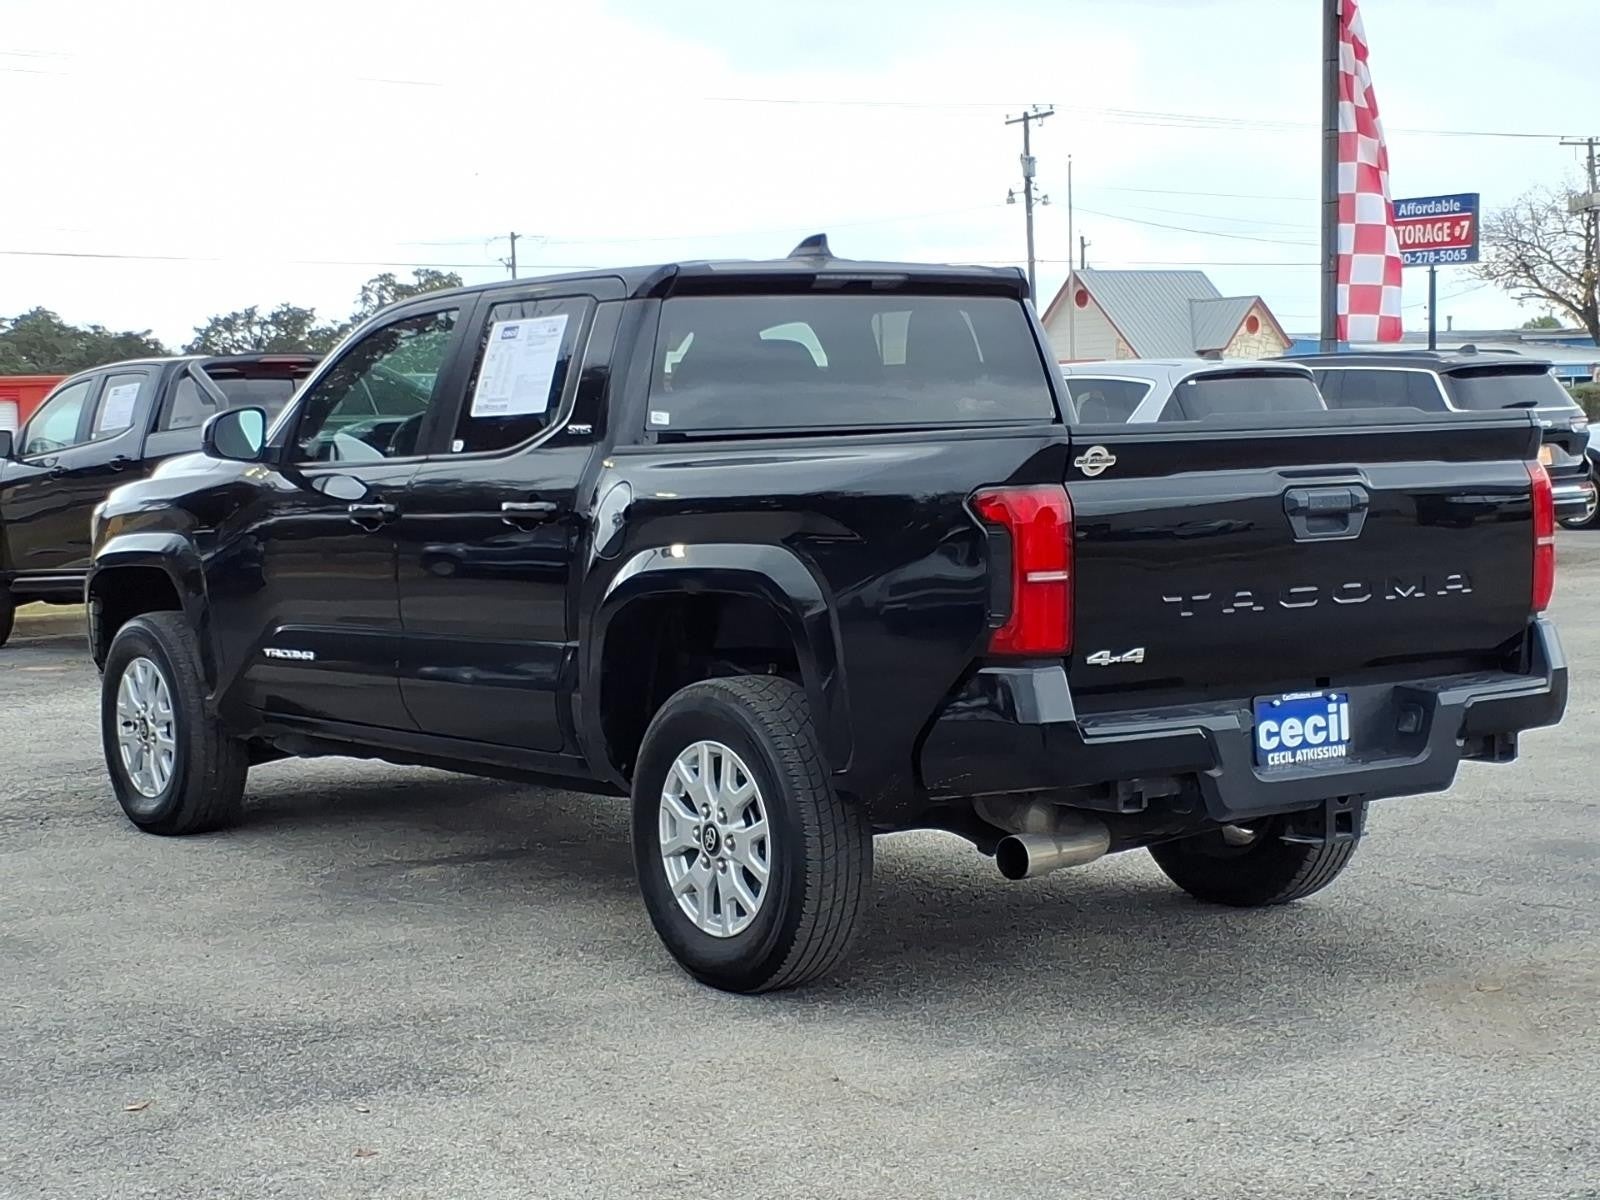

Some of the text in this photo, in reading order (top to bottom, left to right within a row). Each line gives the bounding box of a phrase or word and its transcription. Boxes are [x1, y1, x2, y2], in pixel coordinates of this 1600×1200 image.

[1398, 199, 1461, 217] Affordable
[1395, 222, 1452, 245] TORAGE
[1401, 249, 1468, 264] 0-278-5065
[1162, 574, 1473, 617] TACOMA
[262, 647, 315, 661] TACOMA
[1258, 702, 1351, 751] cecil
[1267, 743, 1347, 766] CECIL ATKISSION
